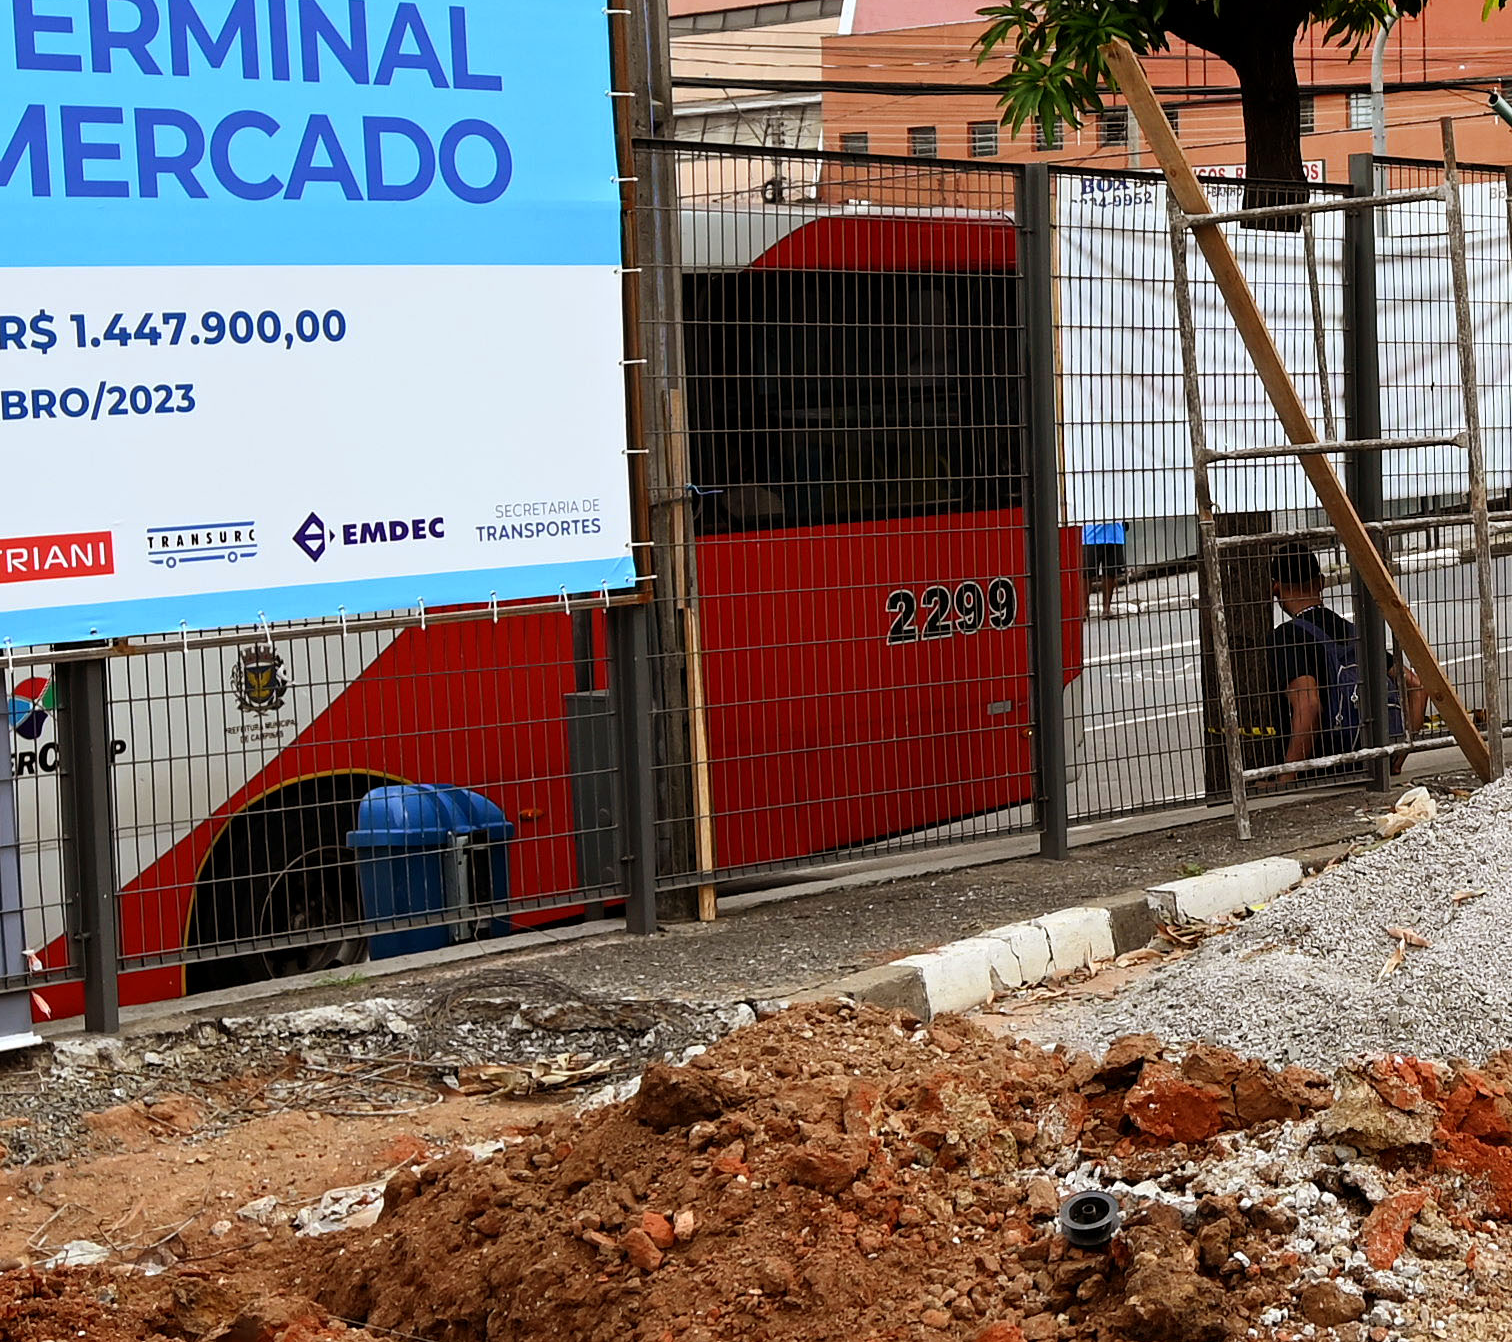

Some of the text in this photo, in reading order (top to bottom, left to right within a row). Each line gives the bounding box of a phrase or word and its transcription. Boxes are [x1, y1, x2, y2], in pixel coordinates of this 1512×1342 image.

[69, 308, 348, 352] 1.447.900,00
[494, 498, 601, 519] SECRETARIA DE
[147, 528, 255, 549] TRANSURC
[342, 516, 445, 546] EMDEC
[475, 517, 601, 542] TRANSPORTES
[885, 577, 1018, 646] 2299
